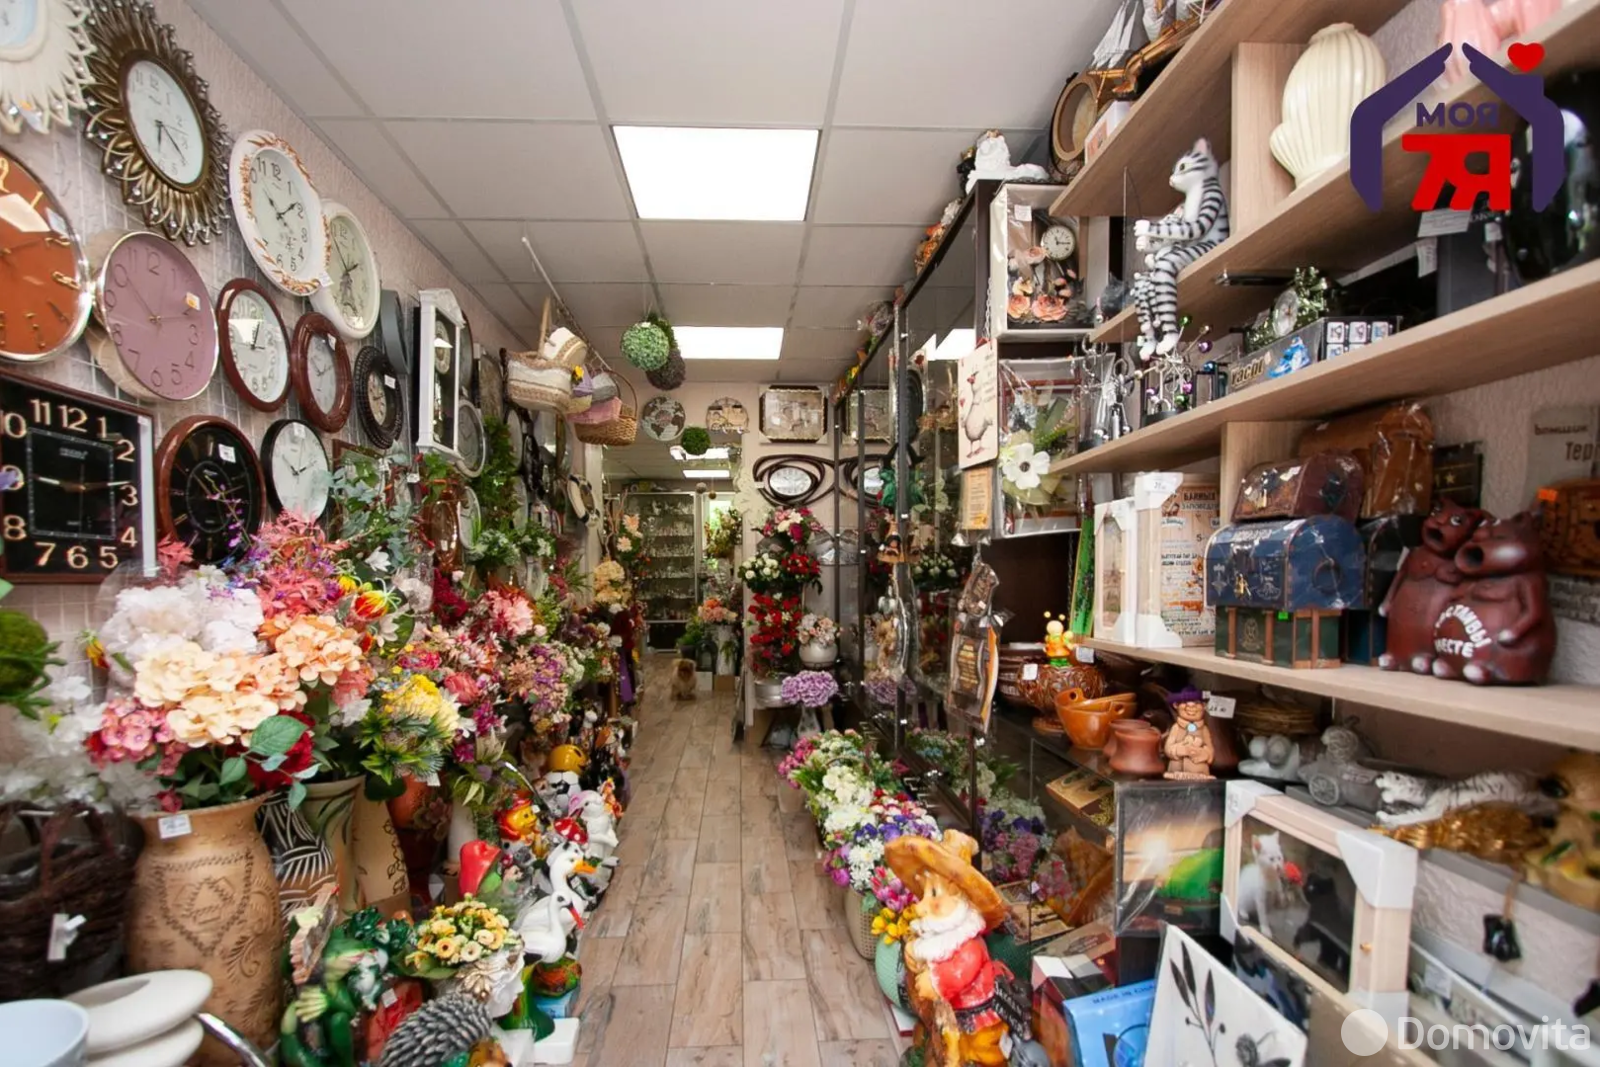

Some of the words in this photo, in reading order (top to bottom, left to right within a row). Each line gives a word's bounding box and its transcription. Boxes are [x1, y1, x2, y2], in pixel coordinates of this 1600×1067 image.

[31, 399, 51, 425] 11
[58, 405, 88, 433] 12
[97, 416, 107, 439] 1
[116, 439, 135, 462] 2
[119, 484, 139, 506] 3
[3, 515, 27, 540] 8
[120, 527, 137, 547] 4
[35, 542, 56, 567] 7
[67, 546, 89, 569] 6
[100, 546, 118, 569] 5
